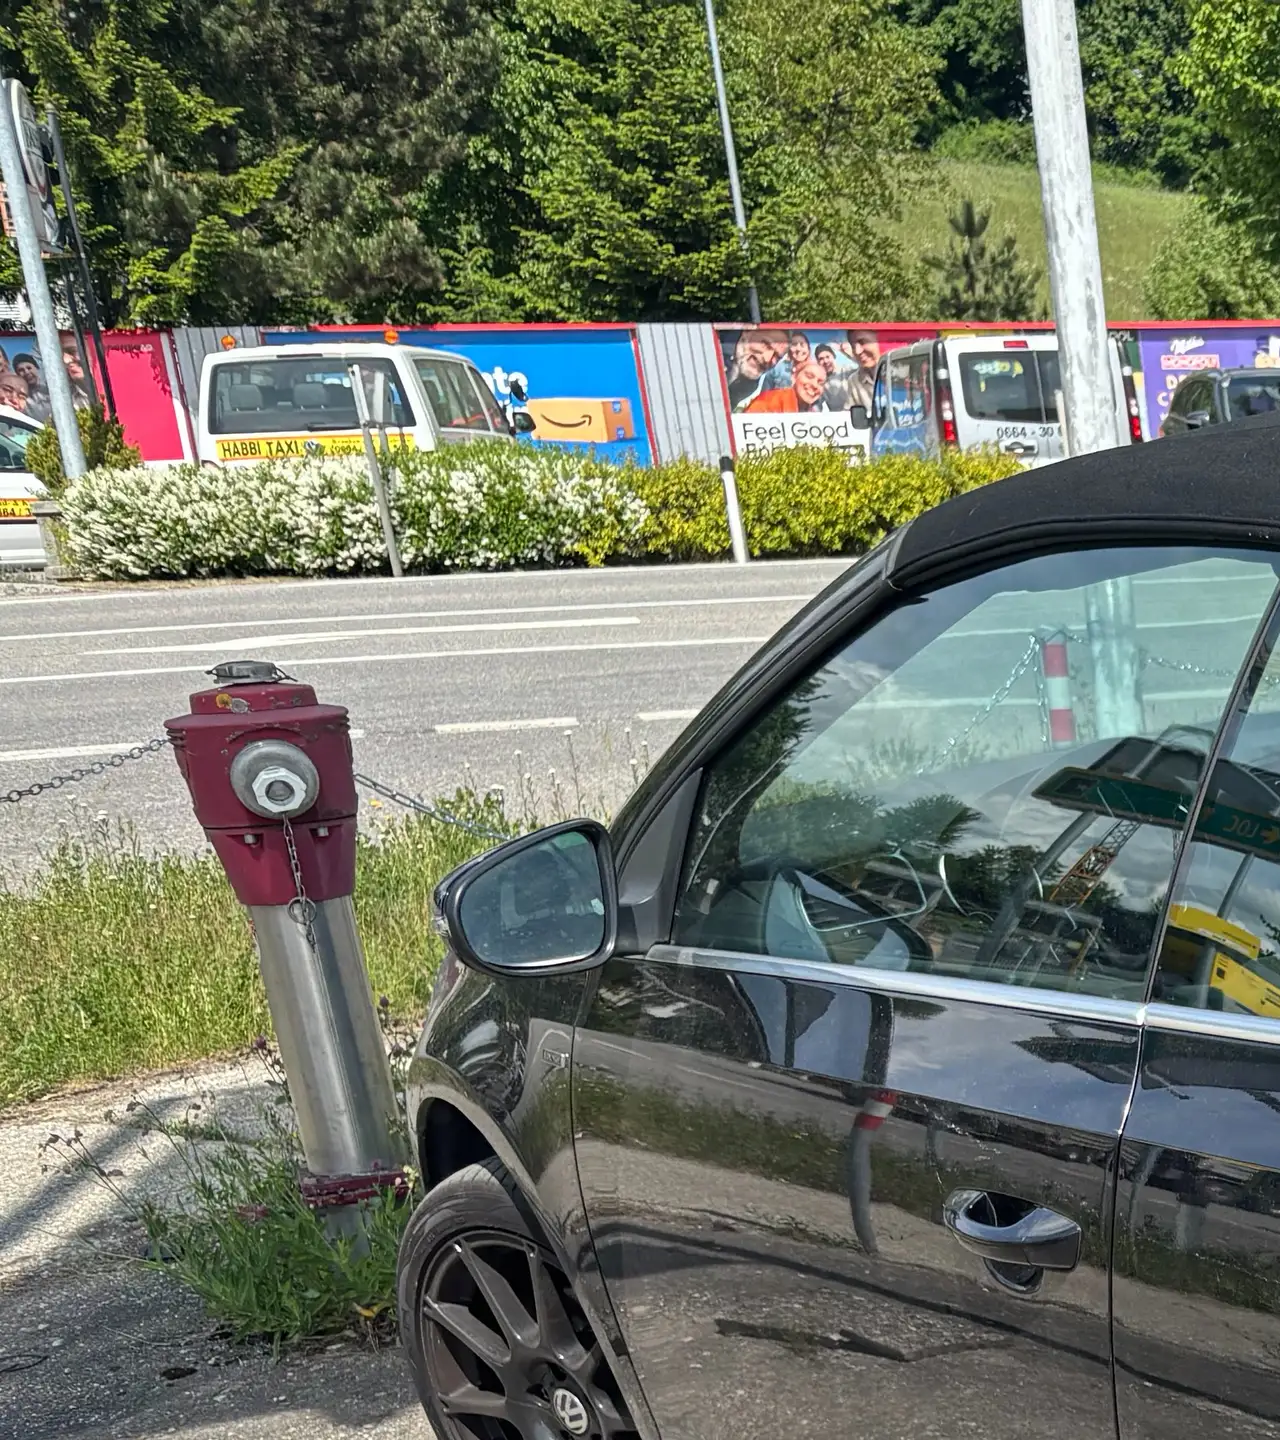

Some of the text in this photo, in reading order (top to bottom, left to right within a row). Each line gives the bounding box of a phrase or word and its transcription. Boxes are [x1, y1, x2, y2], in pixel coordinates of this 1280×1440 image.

[743, 421, 850, 440] Feel Good
[221, 440, 300, 458] HABBI TAXI
